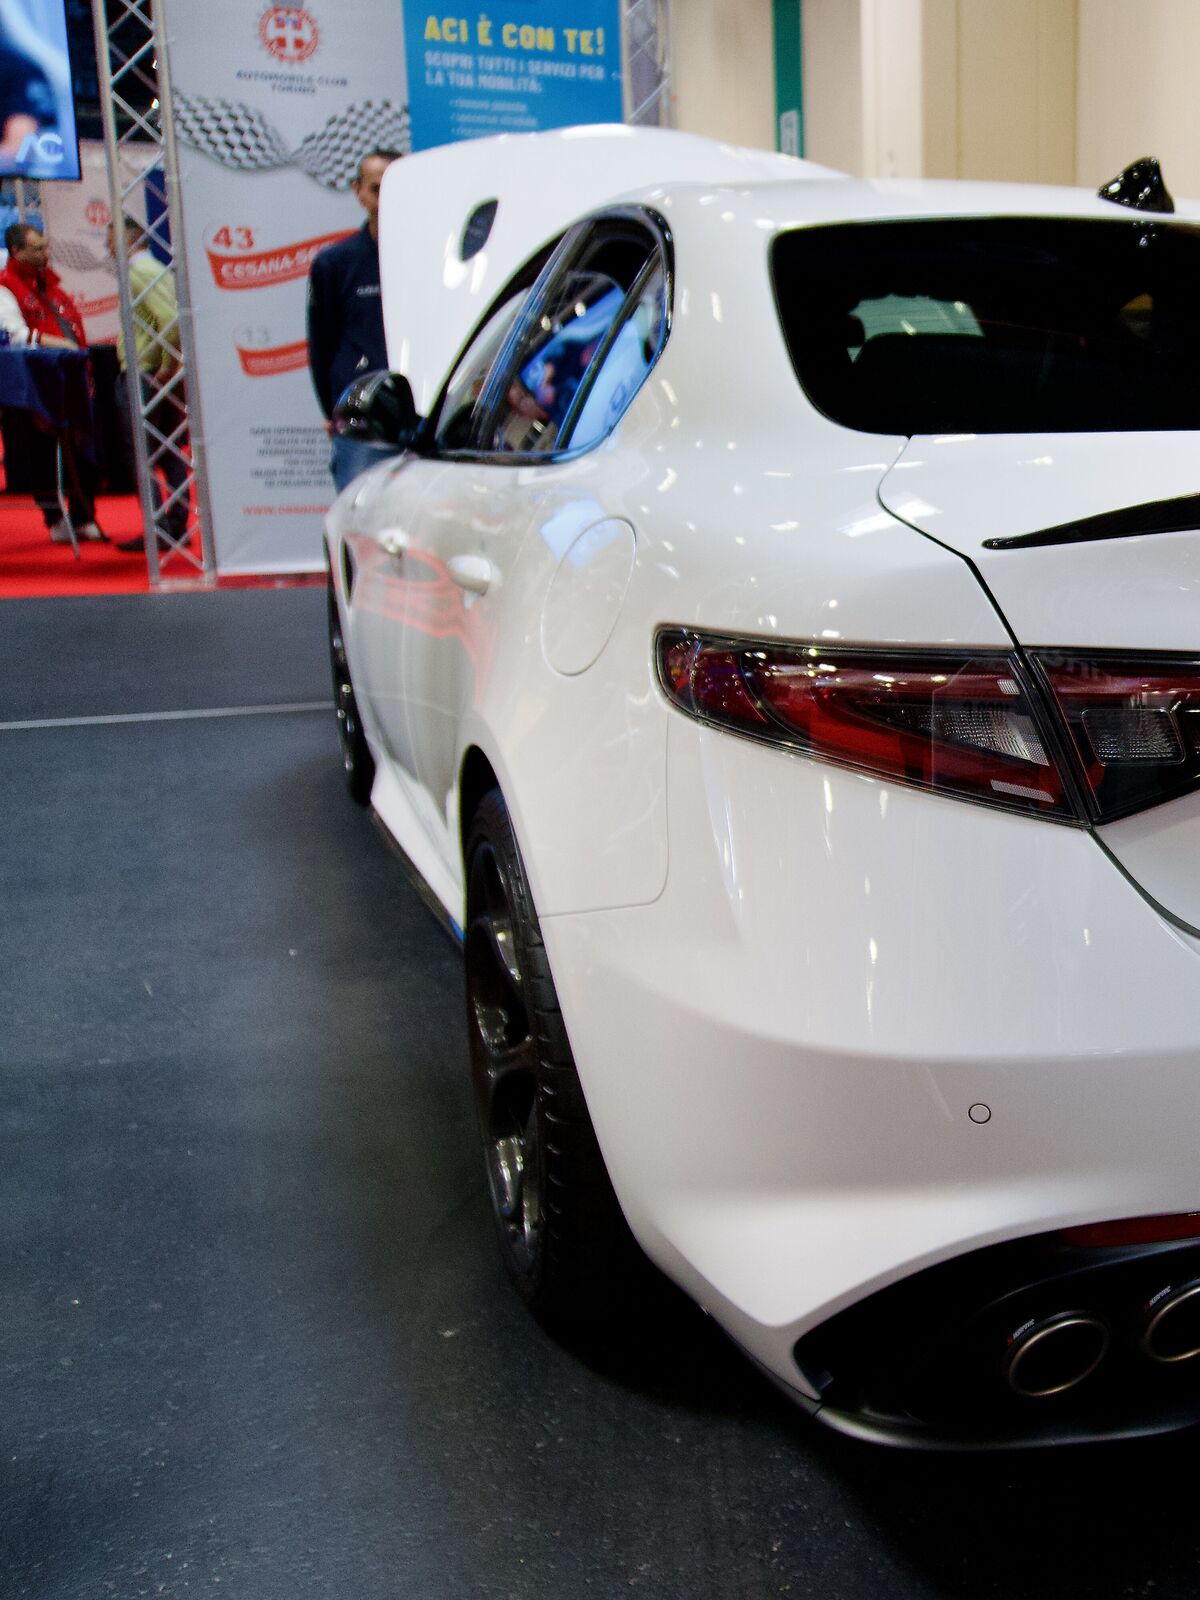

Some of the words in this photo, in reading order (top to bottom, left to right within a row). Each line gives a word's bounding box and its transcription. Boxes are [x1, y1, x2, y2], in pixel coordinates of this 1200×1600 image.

[424, 16, 468, 43] ACI
[502, 23, 555, 51] CON
[563, 27, 605, 55] TE!
[424, 51, 472, 70] SCOPRI
[478, 54, 516, 73] TUTTI
[528, 60, 577, 78] SERVIZI
[580, 64, 604, 80] PER
[425, 70, 444, 86] LA
[449, 71, 474, 88] TUA
[212, 225, 255, 249] 43
